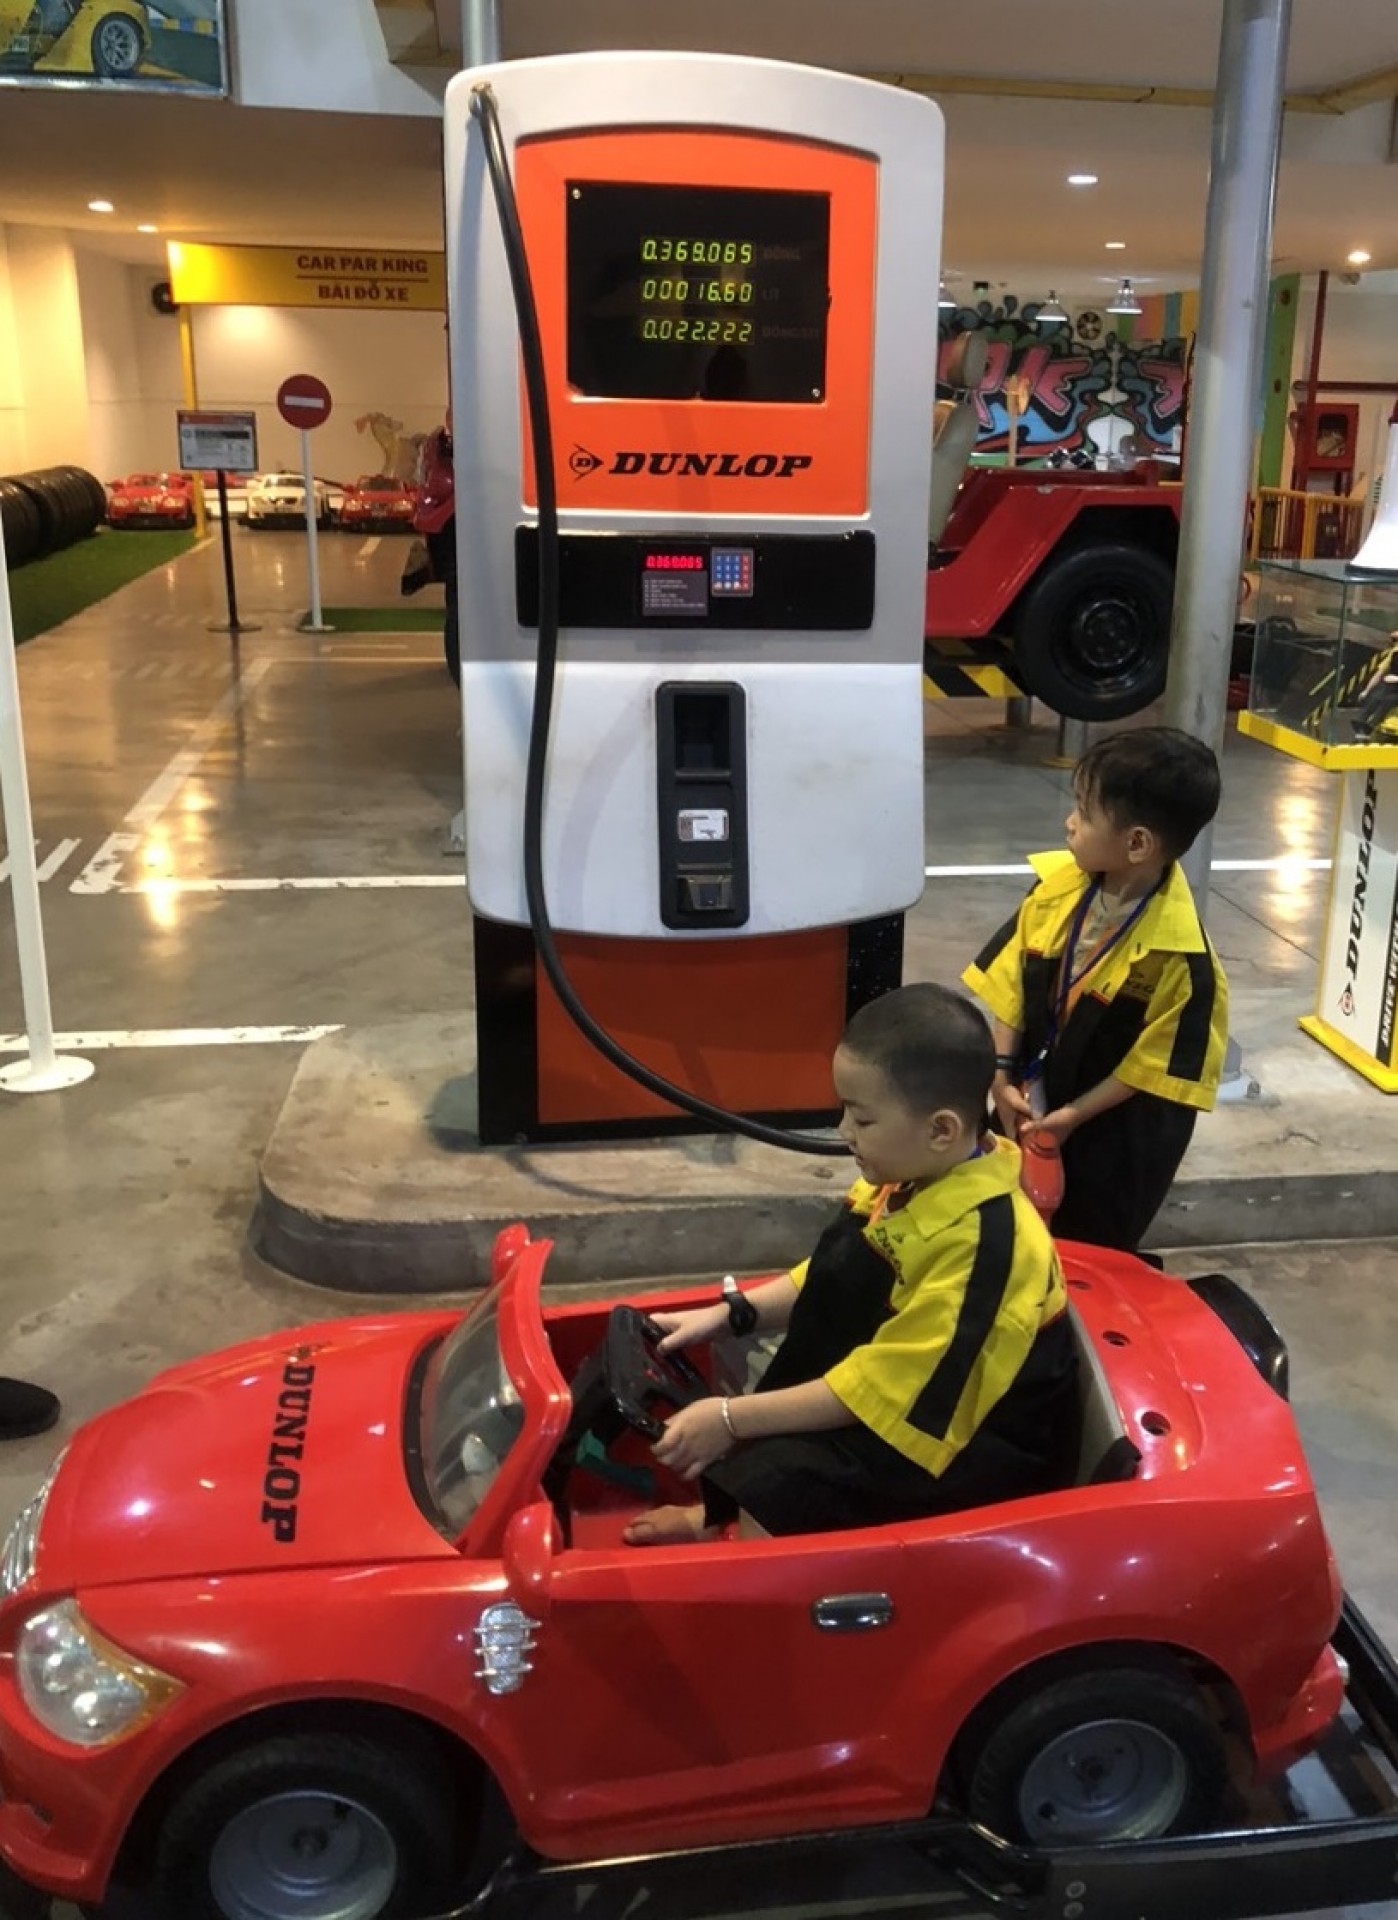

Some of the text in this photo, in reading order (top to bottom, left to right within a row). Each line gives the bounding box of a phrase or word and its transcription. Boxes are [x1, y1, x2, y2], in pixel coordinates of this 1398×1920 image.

[297, 254, 428, 274] CAR PAR KING
[385, 285, 409, 302] XE
[609, 452, 813, 477] DUNLOP
[1345, 768, 1379, 981] DUNLOP
[261, 1365, 315, 1542] DUNLOP
